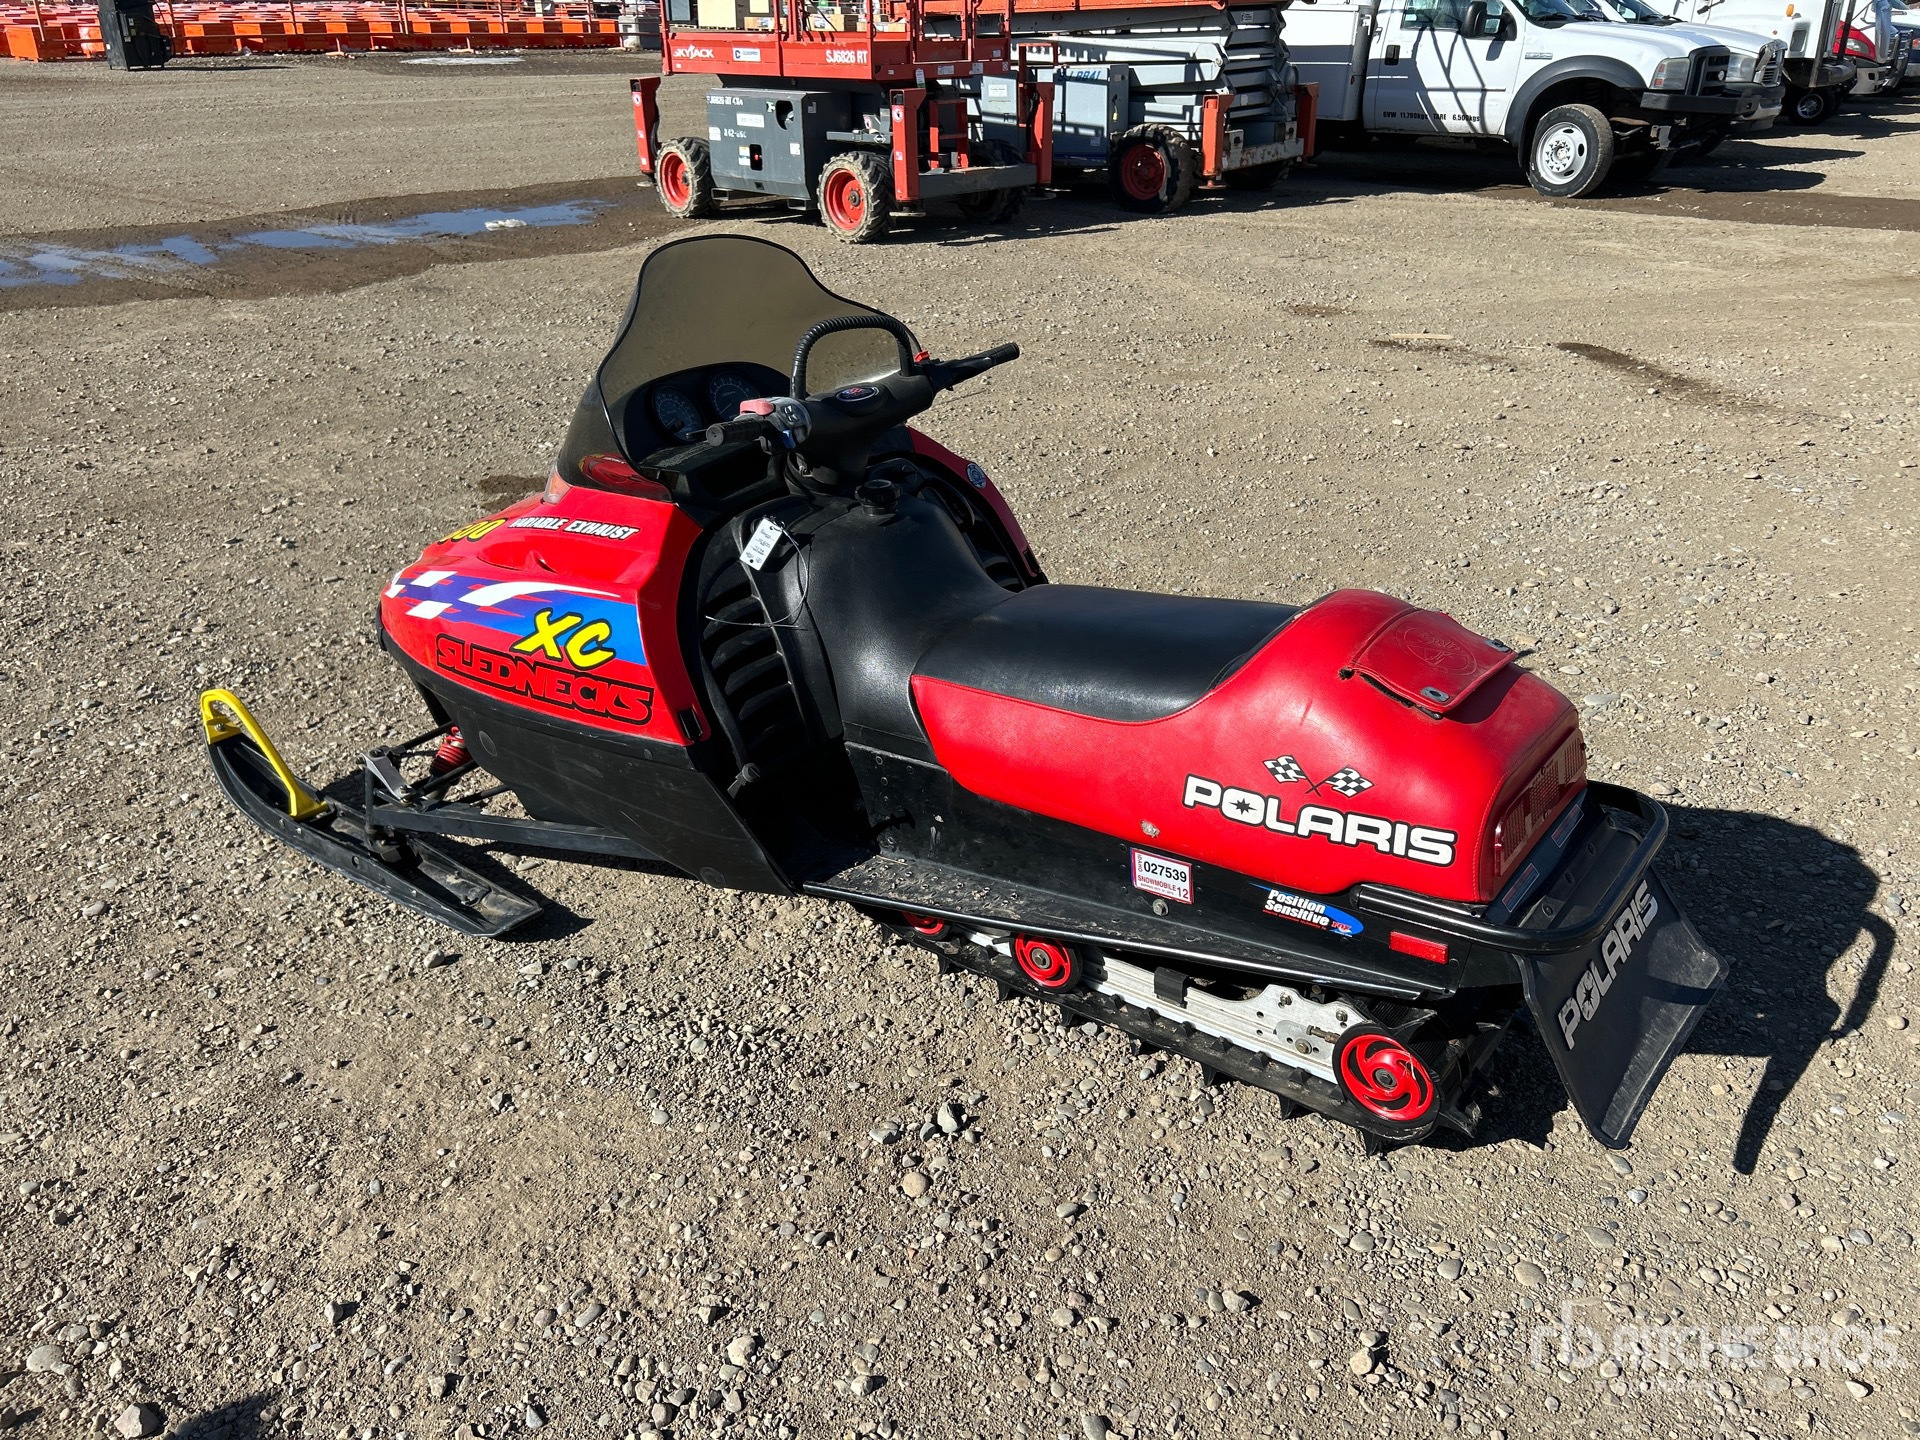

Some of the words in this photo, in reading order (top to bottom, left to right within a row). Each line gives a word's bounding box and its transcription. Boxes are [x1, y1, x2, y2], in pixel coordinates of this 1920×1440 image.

[673, 44, 715, 59] SKYJACK
[826, 50, 856, 63] SJ6826
[857, 51, 868, 63] RT
[509, 517, 569, 530] VARIABLE
[564, 519, 640, 540] EXHAUST
[510, 608, 616, 671] XC
[435, 634, 655, 726] SLEDNECKS
[1183, 774, 1456, 866] POLARIS
[1143, 861, 1187, 882] 027539
[1137, 874, 1177, 891] SNOWMOBILE
[1177, 887, 1188, 899] 12
[1264, 899, 1330, 926] Sensitive
[1268, 889, 1326, 914] Position
[1557, 879, 1659, 1050] POLARIS
